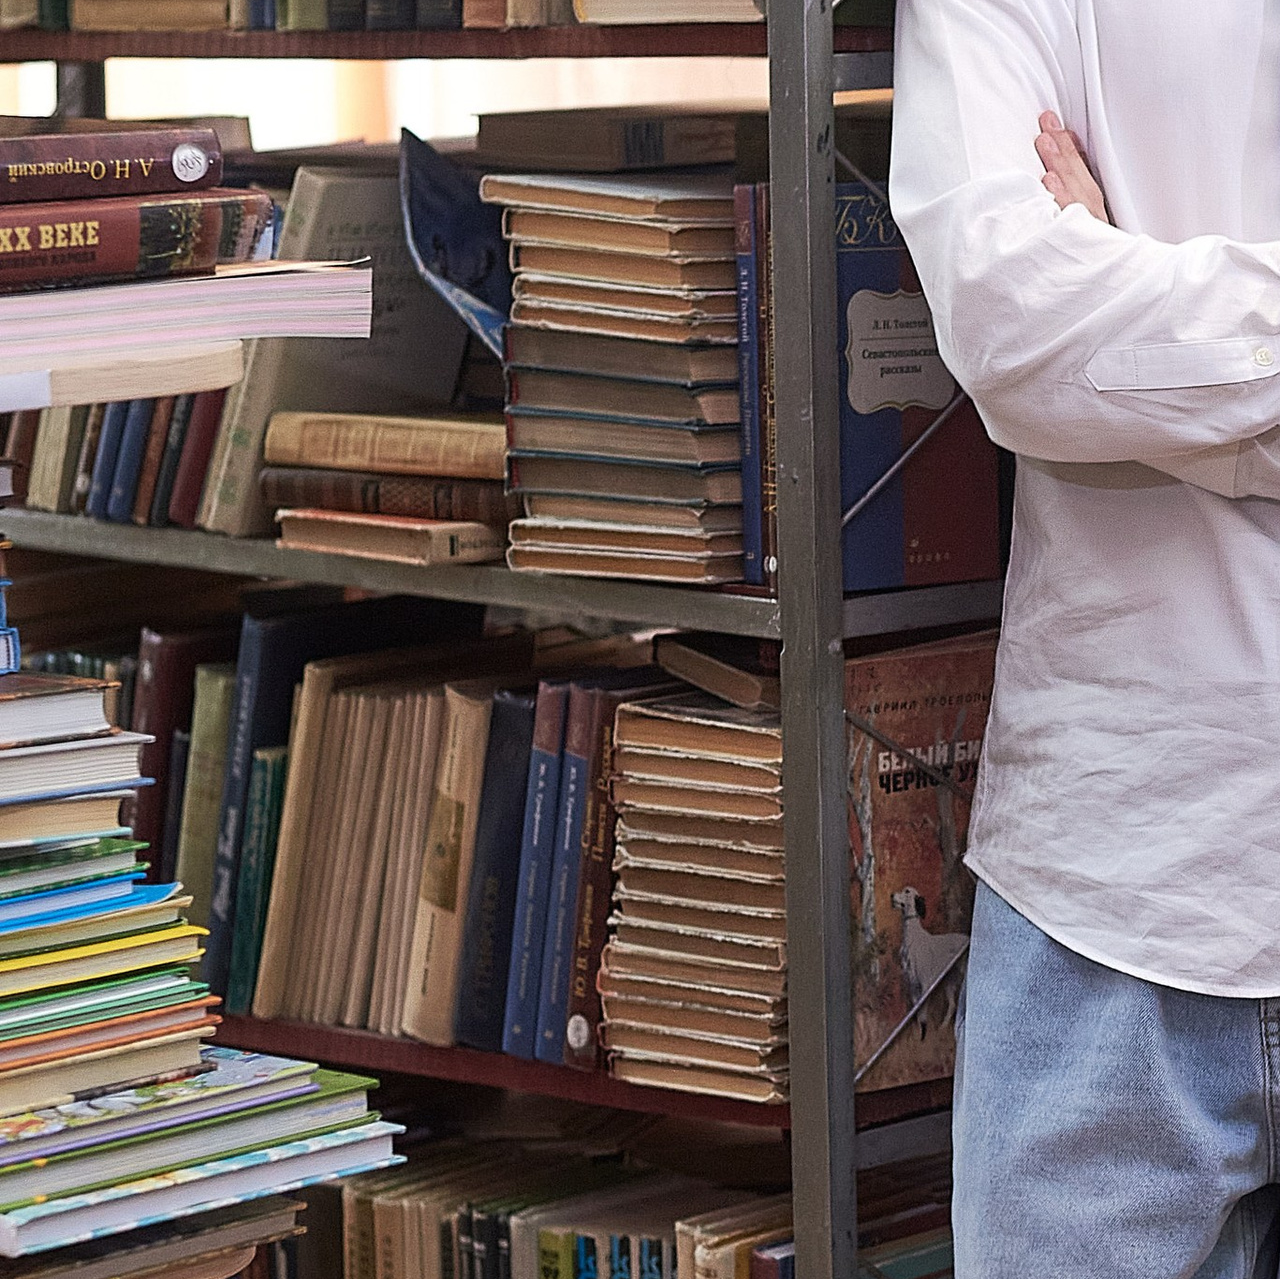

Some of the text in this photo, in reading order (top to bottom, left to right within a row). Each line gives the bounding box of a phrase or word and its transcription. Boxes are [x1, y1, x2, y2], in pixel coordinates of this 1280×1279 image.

[8, 157, 107, 183] Островский
[110, 158, 131, 179] Н.
[38, 221, 100, 250] ВЕКЕ
[894, 319, 929, 330] Толстой
[879, 364, 923, 379] рассказы
